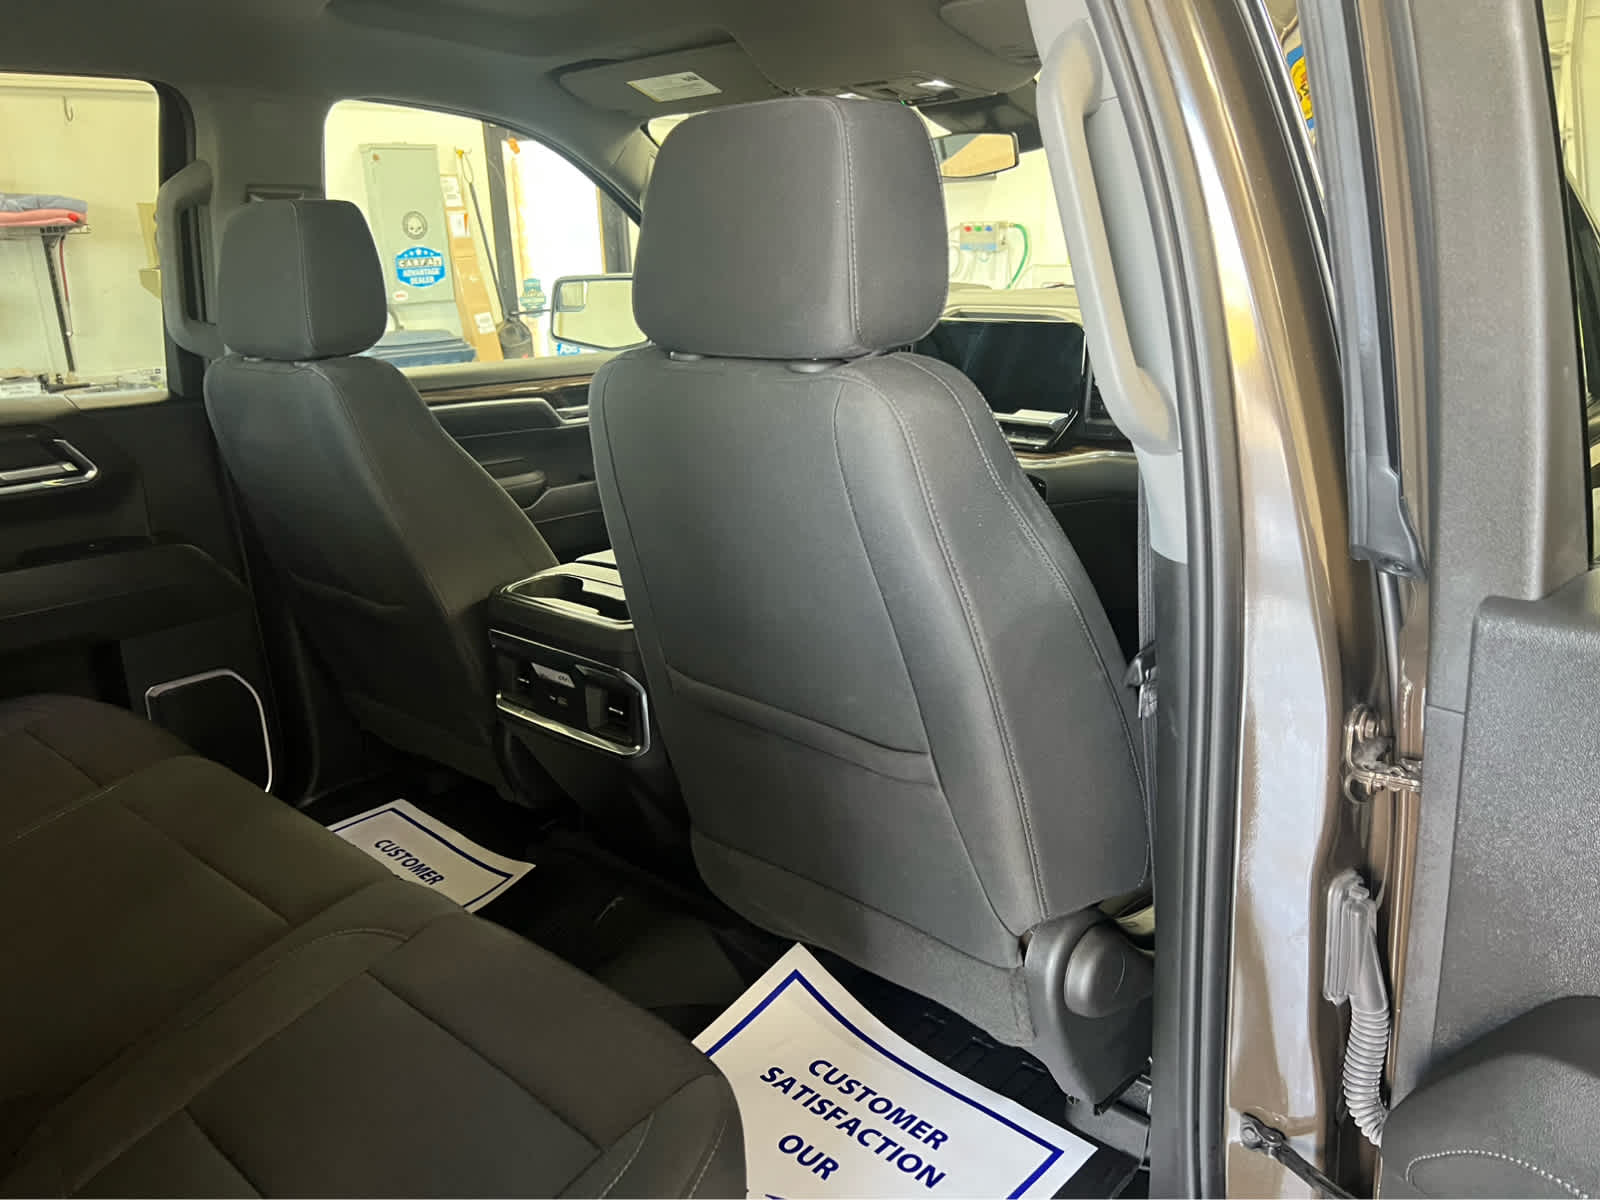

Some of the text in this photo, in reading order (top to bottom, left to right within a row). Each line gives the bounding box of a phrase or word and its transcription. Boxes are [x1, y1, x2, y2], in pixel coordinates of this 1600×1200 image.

[374, 839, 445, 885] CUSTOMER
[760, 1066, 946, 1188] SATISFACTION
[808, 1059, 950, 1151] CUSTOMER
[778, 1134, 840, 1181] OUR
